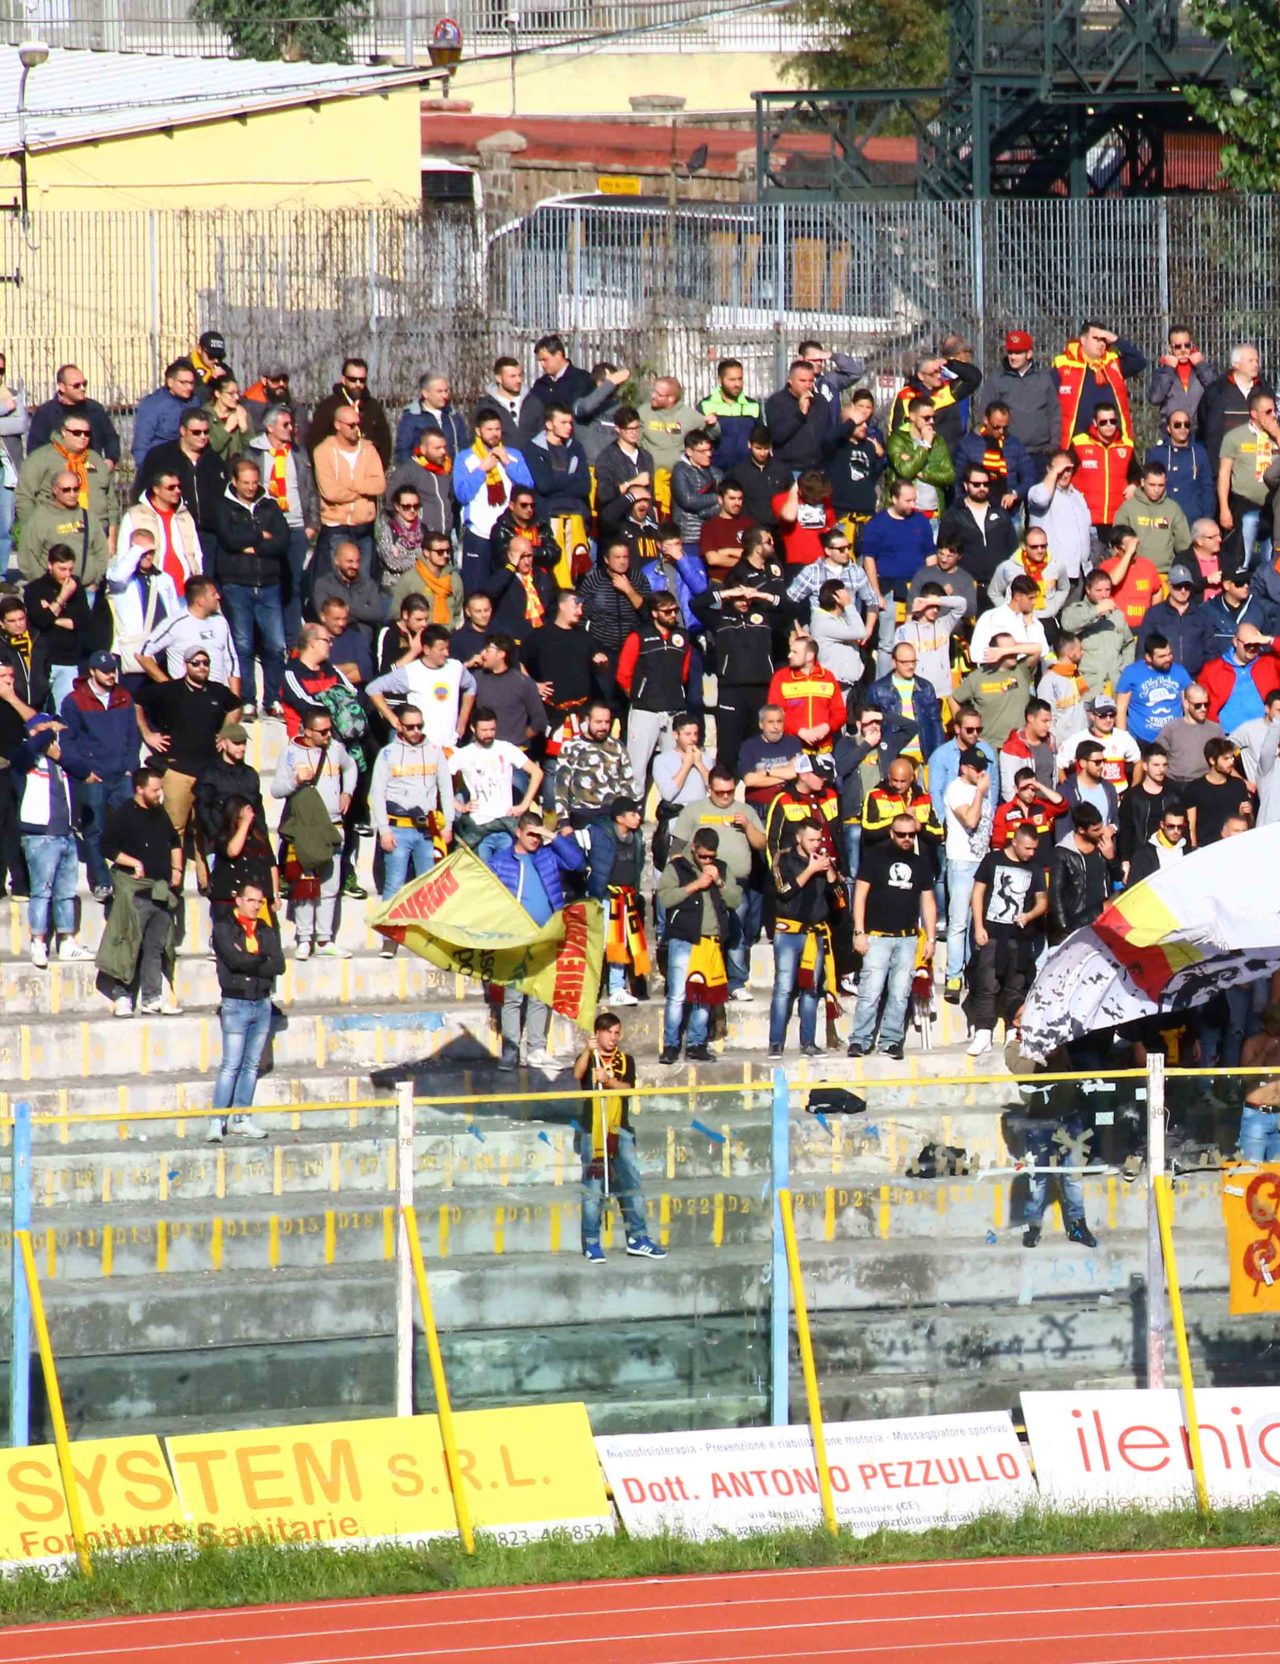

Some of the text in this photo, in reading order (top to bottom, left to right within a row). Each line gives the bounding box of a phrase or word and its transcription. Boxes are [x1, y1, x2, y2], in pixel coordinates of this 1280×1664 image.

[705, 1437, 766, 1454] Prevenzione
[892, 1425, 966, 1442] Massaggiatore
[8, 1438, 551, 1523] SYSTEM S.R.L.
[622, 1452, 1020, 1504] Dott. ANTONO PEZZULLO
[20, 1523, 185, 1557] Forniture
[197, 1513, 359, 1549] Sanitarie
